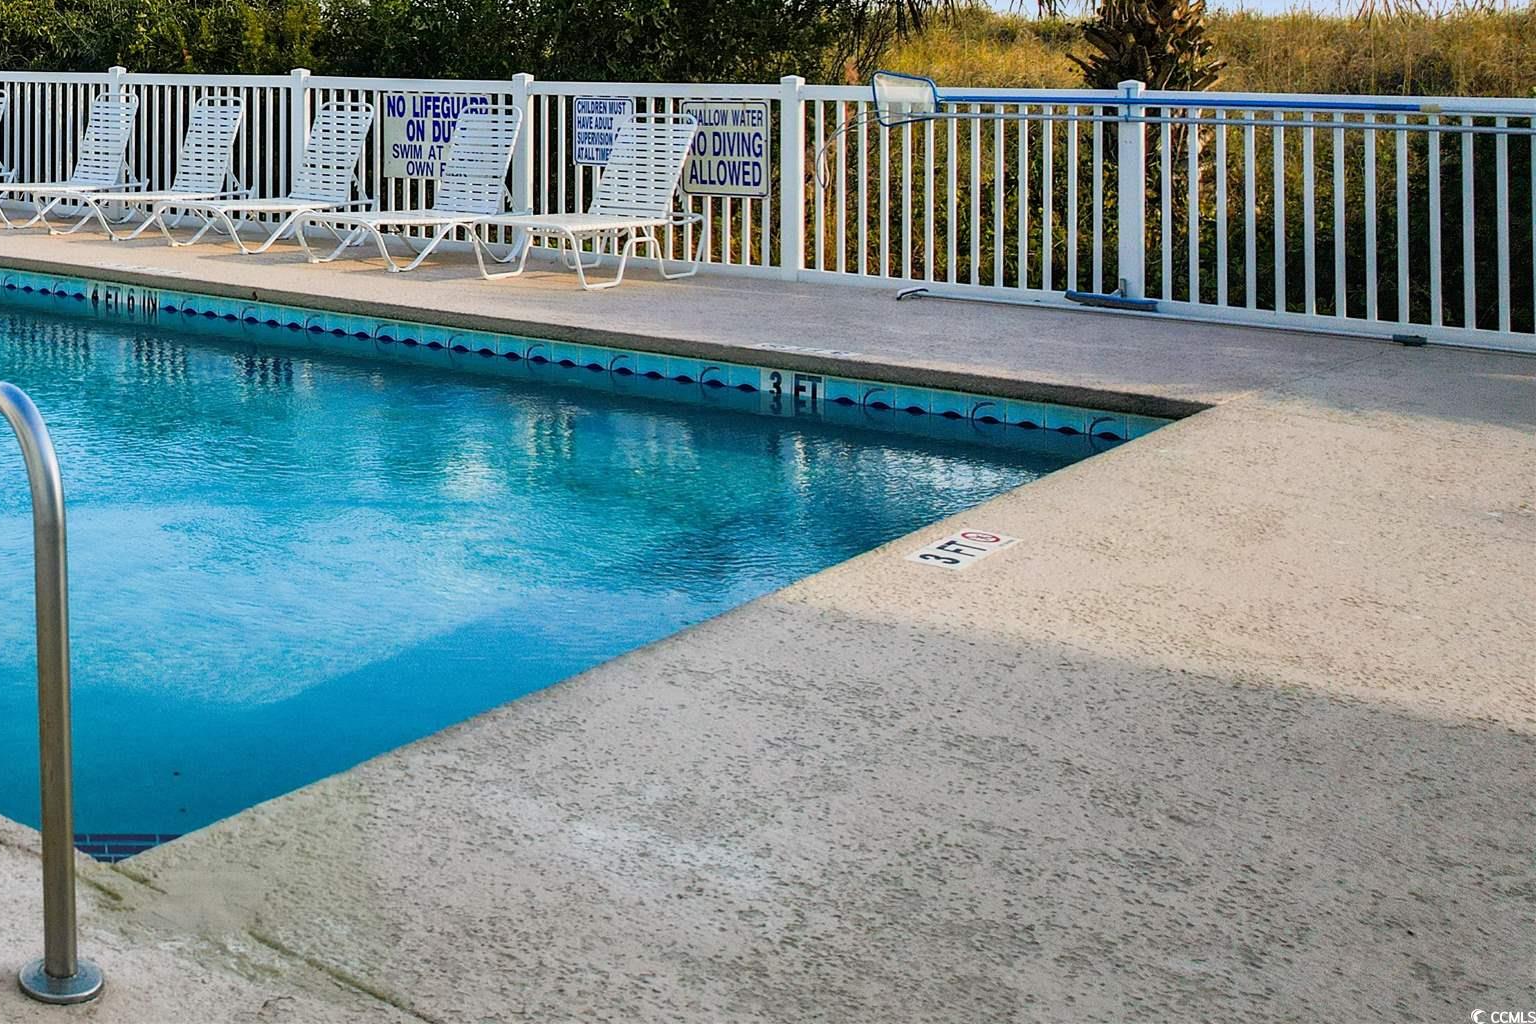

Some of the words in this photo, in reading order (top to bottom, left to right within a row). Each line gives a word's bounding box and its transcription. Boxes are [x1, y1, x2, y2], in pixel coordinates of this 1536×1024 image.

[387, 96, 405, 117] NO
[577, 101, 607, 114] CHILDREN
[609, 102, 626, 115] MUST
[577, 116, 593, 129] HAVE
[595, 117, 613, 130] ADULT
[732, 109, 763, 127] WATER
[406, 119, 425, 142] ON
[577, 132, 613, 145] SUPERVISION
[392, 143, 422, 159] SWIM
[428, 145, 444, 160] AT
[712, 131, 763, 158] DIVING
[577, 147, 584, 161] AT
[584, 147, 595, 161] ALL
[406, 160, 434, 177] OWN
[689, 159, 762, 187] ALLOWED
[92, 283, 99, 301] 4
[105, 286, 121, 304] FT
[143, 290, 157, 311] IN
[769, 371, 782, 395] 3
[794, 373, 822, 400] FT
[936, 540, 988, 557] FT
[919, 553, 961, 565] 3
